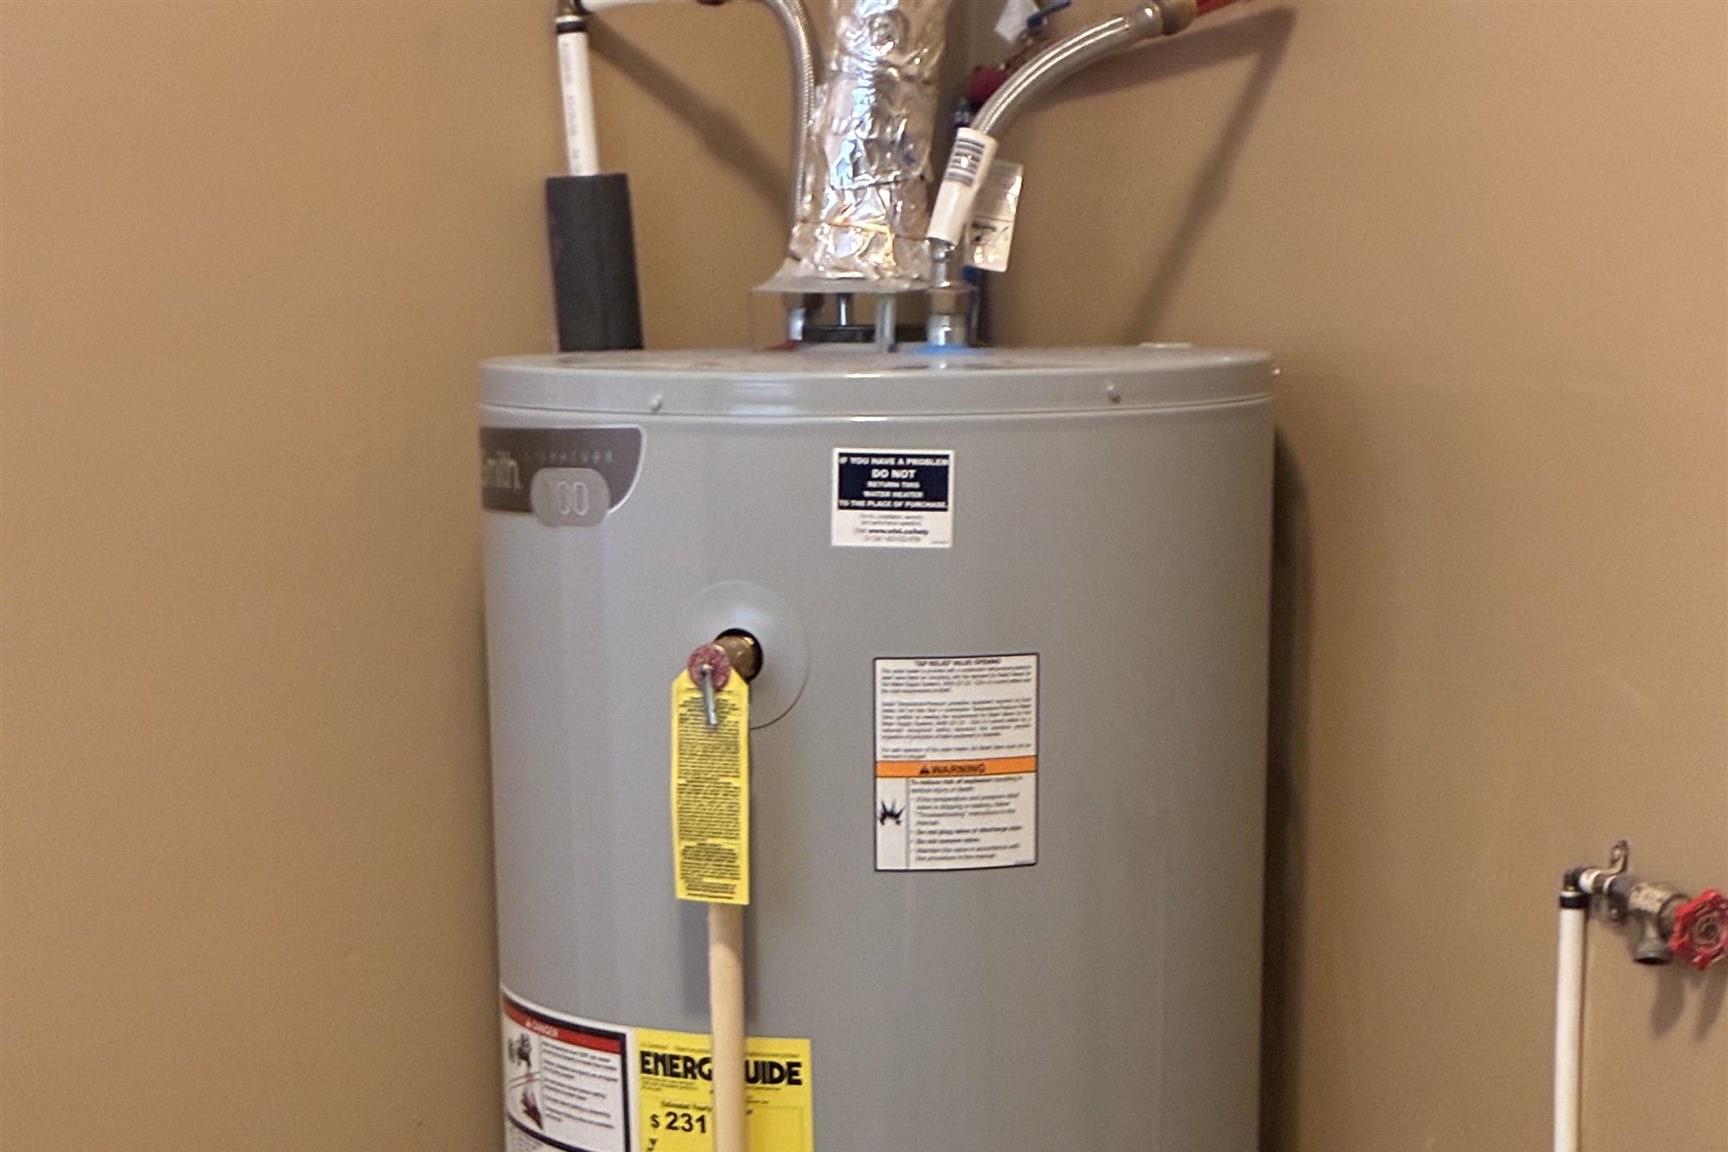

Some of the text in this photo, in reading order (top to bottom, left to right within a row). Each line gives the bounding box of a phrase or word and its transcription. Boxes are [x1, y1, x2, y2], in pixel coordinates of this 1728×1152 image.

[849, 457, 870, 465] YOU
[871, 457, 896, 466] HAVE
[897, 458, 905, 466] A
[871, 468, 917, 479] DO NOT
[932, 763, 986, 775] WARNING
[640, 1050, 803, 1086] ENERGUIDE
[665, 1111, 706, 1134] 231
